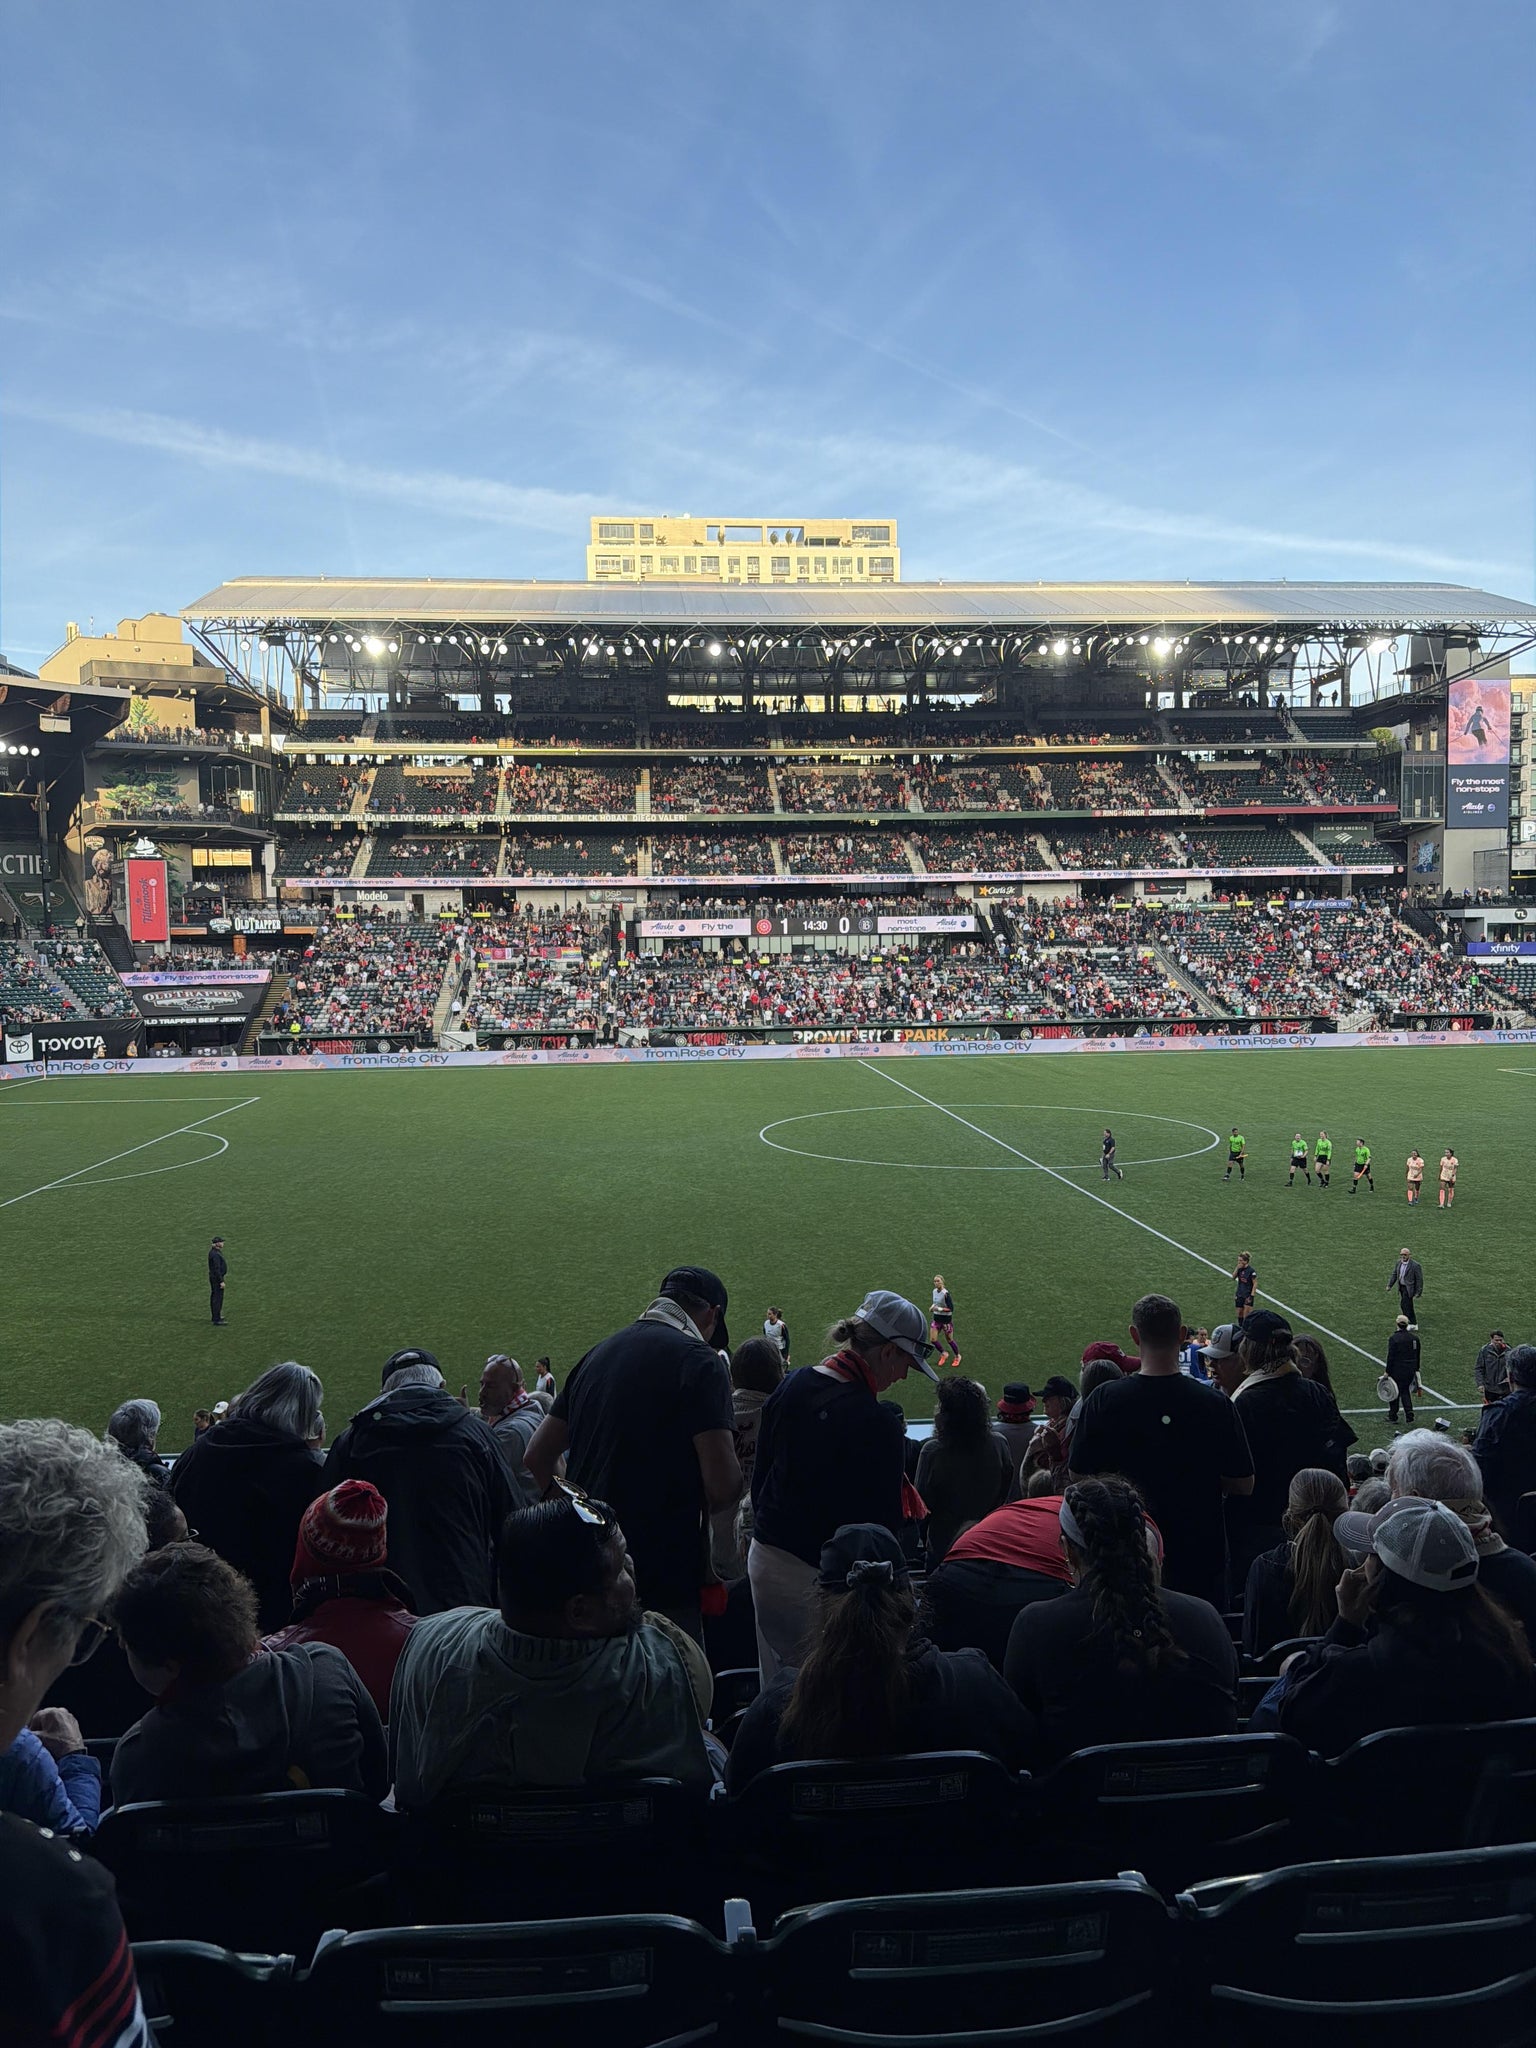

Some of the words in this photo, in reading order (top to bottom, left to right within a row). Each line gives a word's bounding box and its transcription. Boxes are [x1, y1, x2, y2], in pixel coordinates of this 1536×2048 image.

[1451, 778, 1464, 786] Fly
[1462, 802, 1484, 810] Alaska
[139, 878, 152, 924] Tillamook
[356, 890, 388, 901] Modelo
[234, 918, 249, 931] OLD
[250, 917, 281, 931] TRAPPER
[650, 922, 674, 930] Alaska
[780, 918, 788, 934] 1
[803, 921, 828, 930] 14:30
[839, 917, 850, 934] 0
[1490, 944, 1520, 953] xfinity
[144, 992, 172, 1001] OLD
[174, 988, 244, 999] TRAPPER
[905, 1028, 950, 1041] PARK
[1032, 1026, 1071, 1038] THORNS
[1497, 1032, 1528, 1040] from
[38, 1036, 105, 1052] TOYOTA
[1218, 1037, 1251, 1046] from
[1289, 1036, 1317, 1045] City
[645, 1049, 678, 1058] from
[680, 1048, 714, 1057] Rose
[717, 1047, 745, 1057] City
[933, 1043, 966, 1052] from
[968, 1042, 1002, 1051] Rose
[1004, 1042, 1032, 1051] City
[342, 1055, 377, 1064] from
[380, 1055, 416, 1064] Rose
[419, 1054, 448, 1064] City
[25, 1063, 60, 1073] from
[62, 1062, 100, 1071] Rose
[103, 1061, 134, 1071] City
